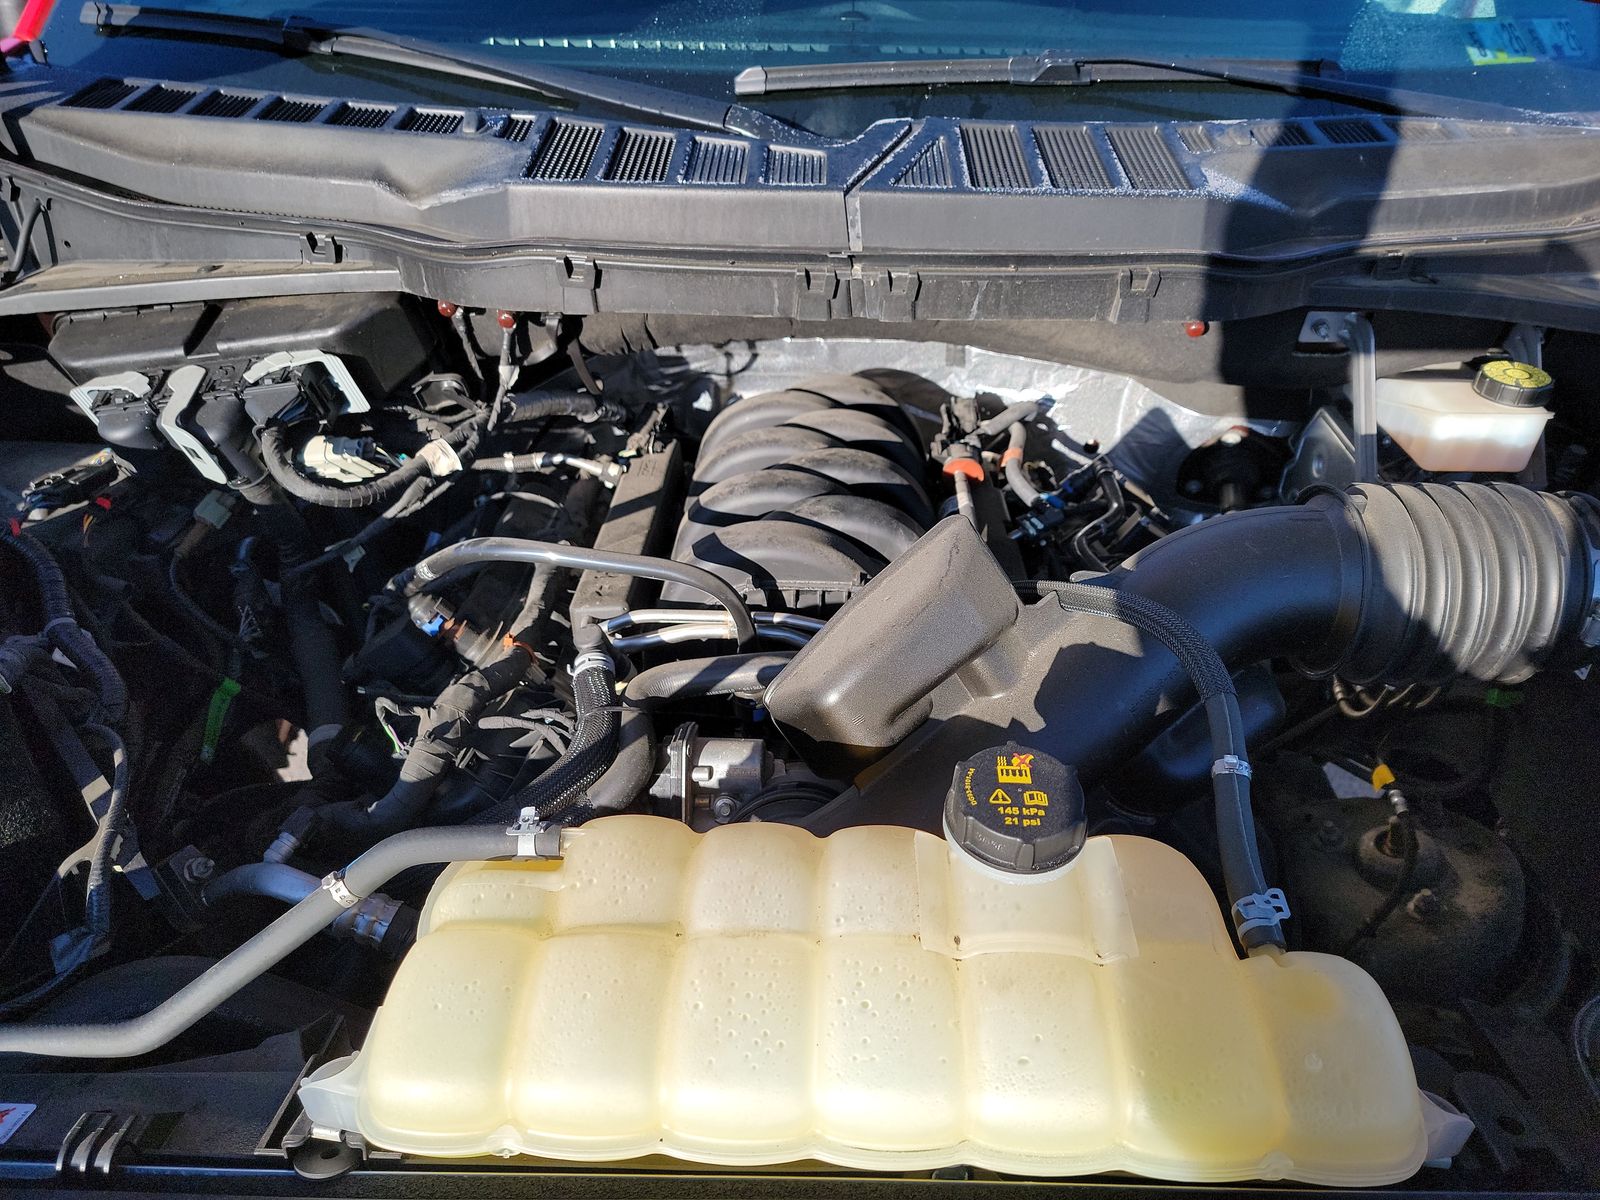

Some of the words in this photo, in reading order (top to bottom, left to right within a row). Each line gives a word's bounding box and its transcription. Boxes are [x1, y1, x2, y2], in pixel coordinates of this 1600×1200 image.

[997, 806, 1020, 815] 145
[1022, 807, 1046, 816] kPa
[1004, 816, 1019, 825] 21
[1022, 818, 1041, 827] psi
